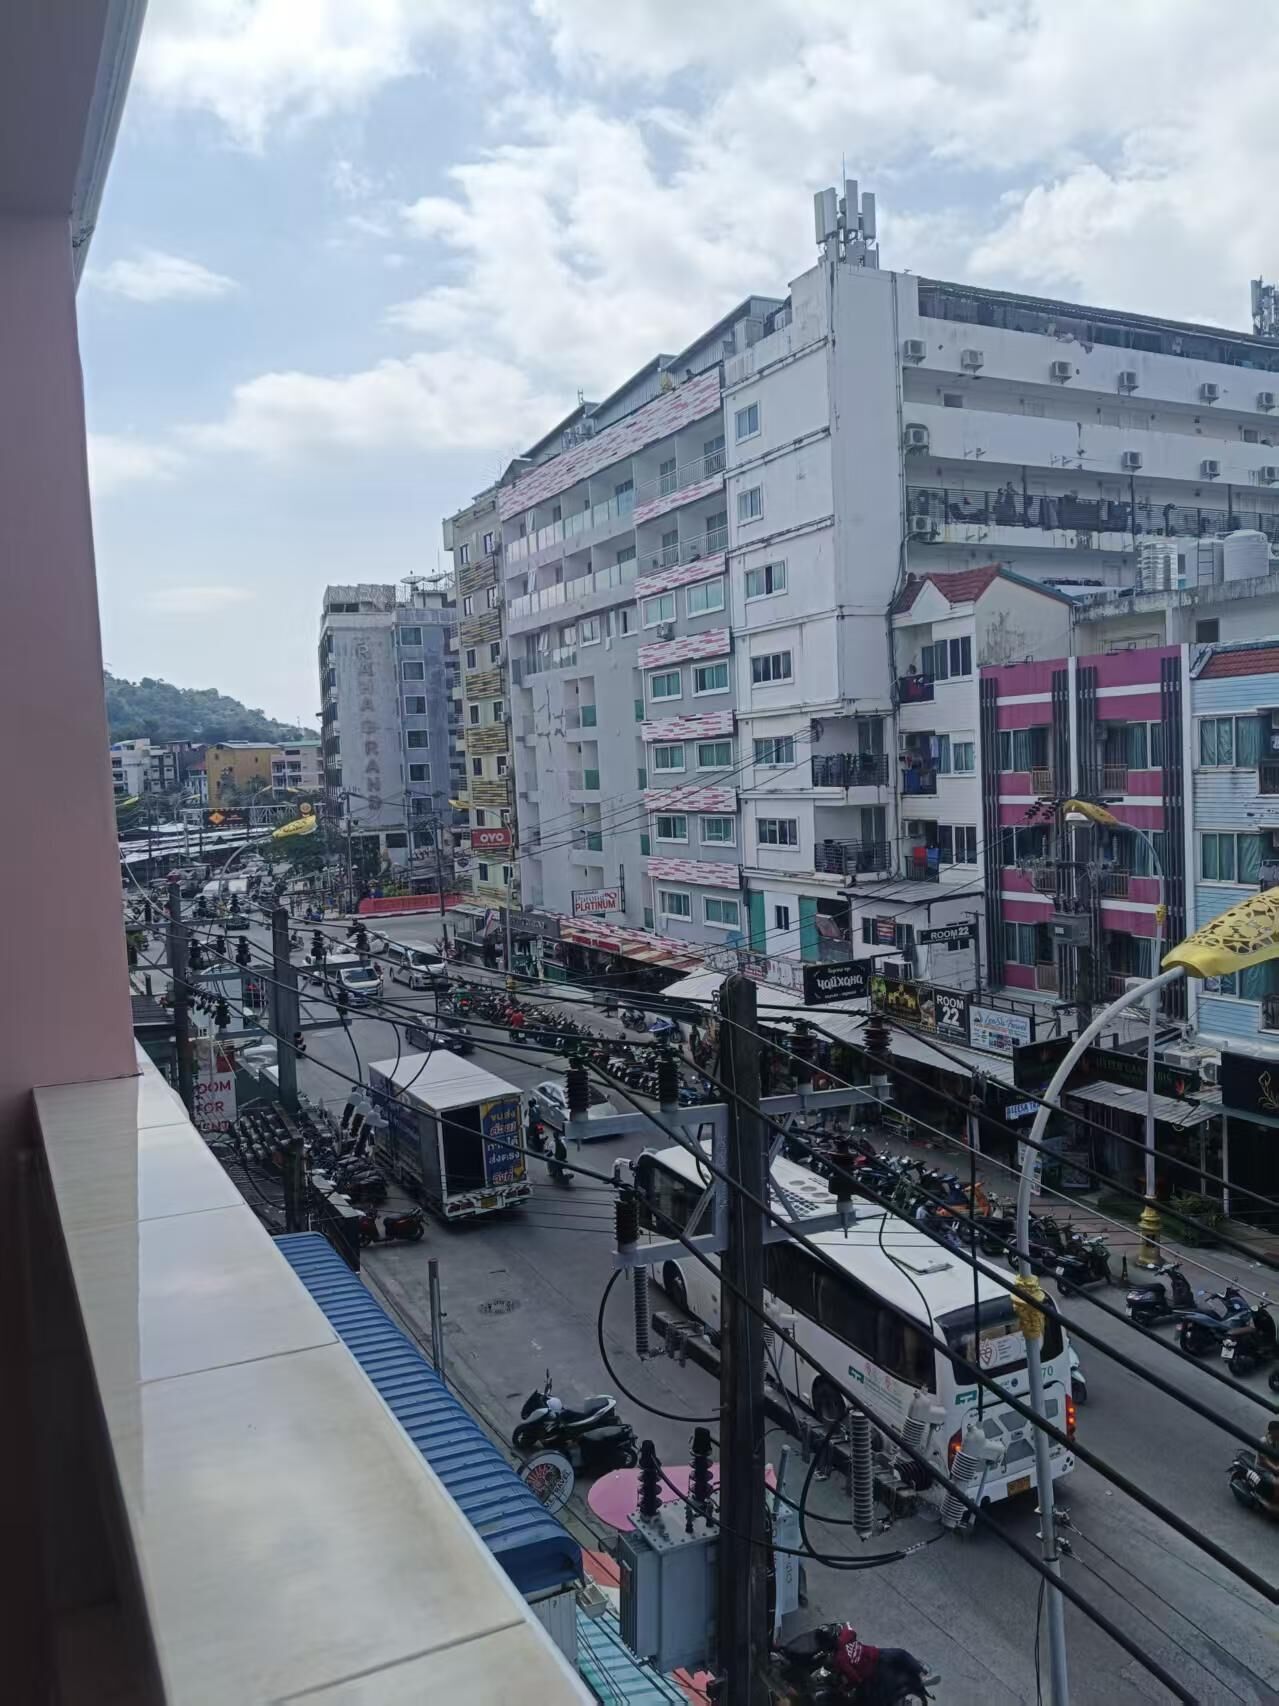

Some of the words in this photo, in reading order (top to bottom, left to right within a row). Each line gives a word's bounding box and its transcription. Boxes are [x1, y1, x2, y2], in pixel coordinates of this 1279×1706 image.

[480, 832, 504, 843] OYO
[575, 899, 616, 912] PLATINUM
[930, 929, 958, 940] ROOM
[958, 926, 969, 936] 22
[936, 995, 964, 1010] ROOM
[942, 1007, 960, 1027] 22
